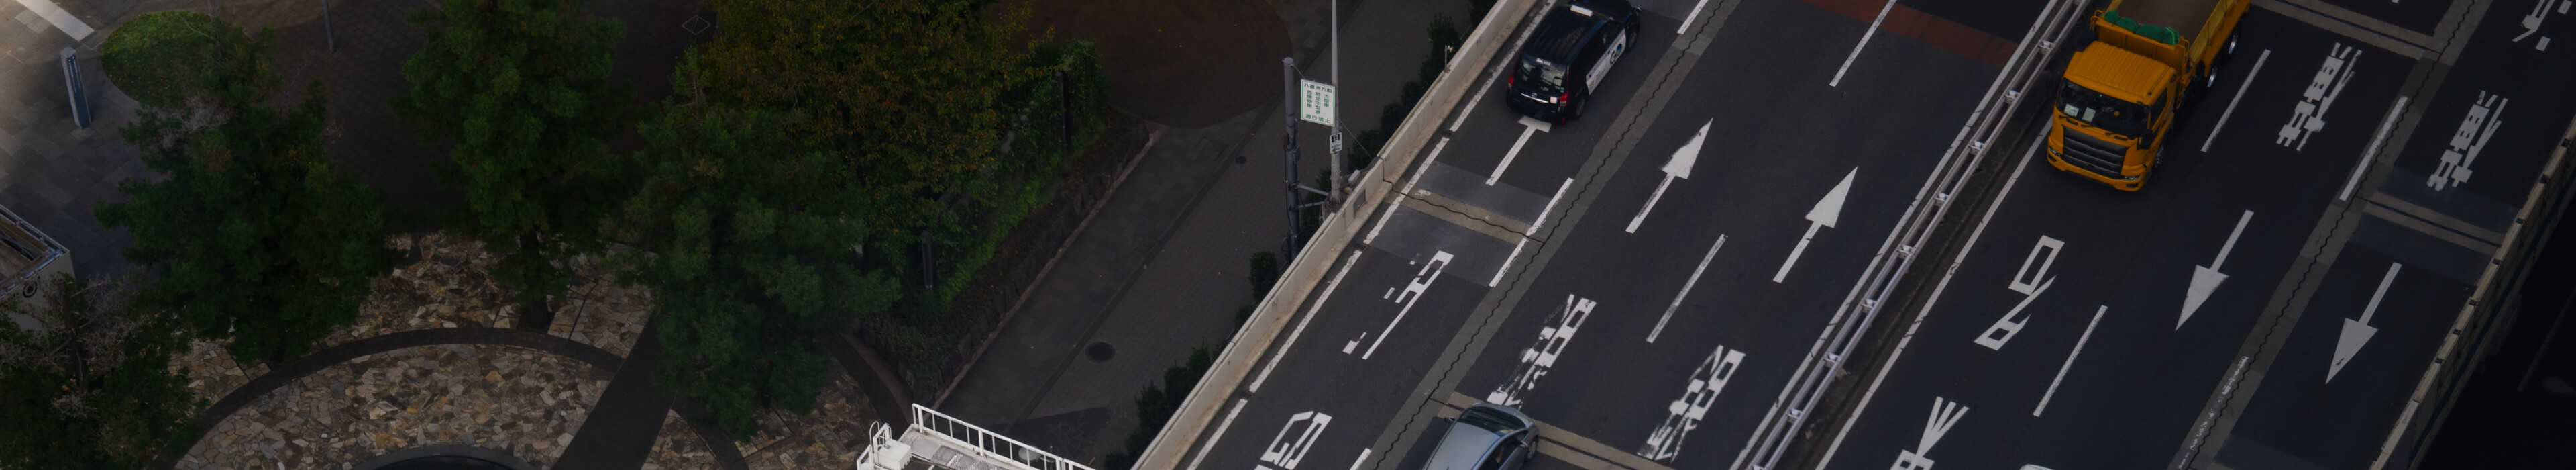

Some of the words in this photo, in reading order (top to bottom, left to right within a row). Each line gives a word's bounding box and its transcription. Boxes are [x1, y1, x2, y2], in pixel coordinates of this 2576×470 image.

[1303, 83, 1332, 93] 八重洲方面
[1305, 113, 1330, 124] 通行禁止
